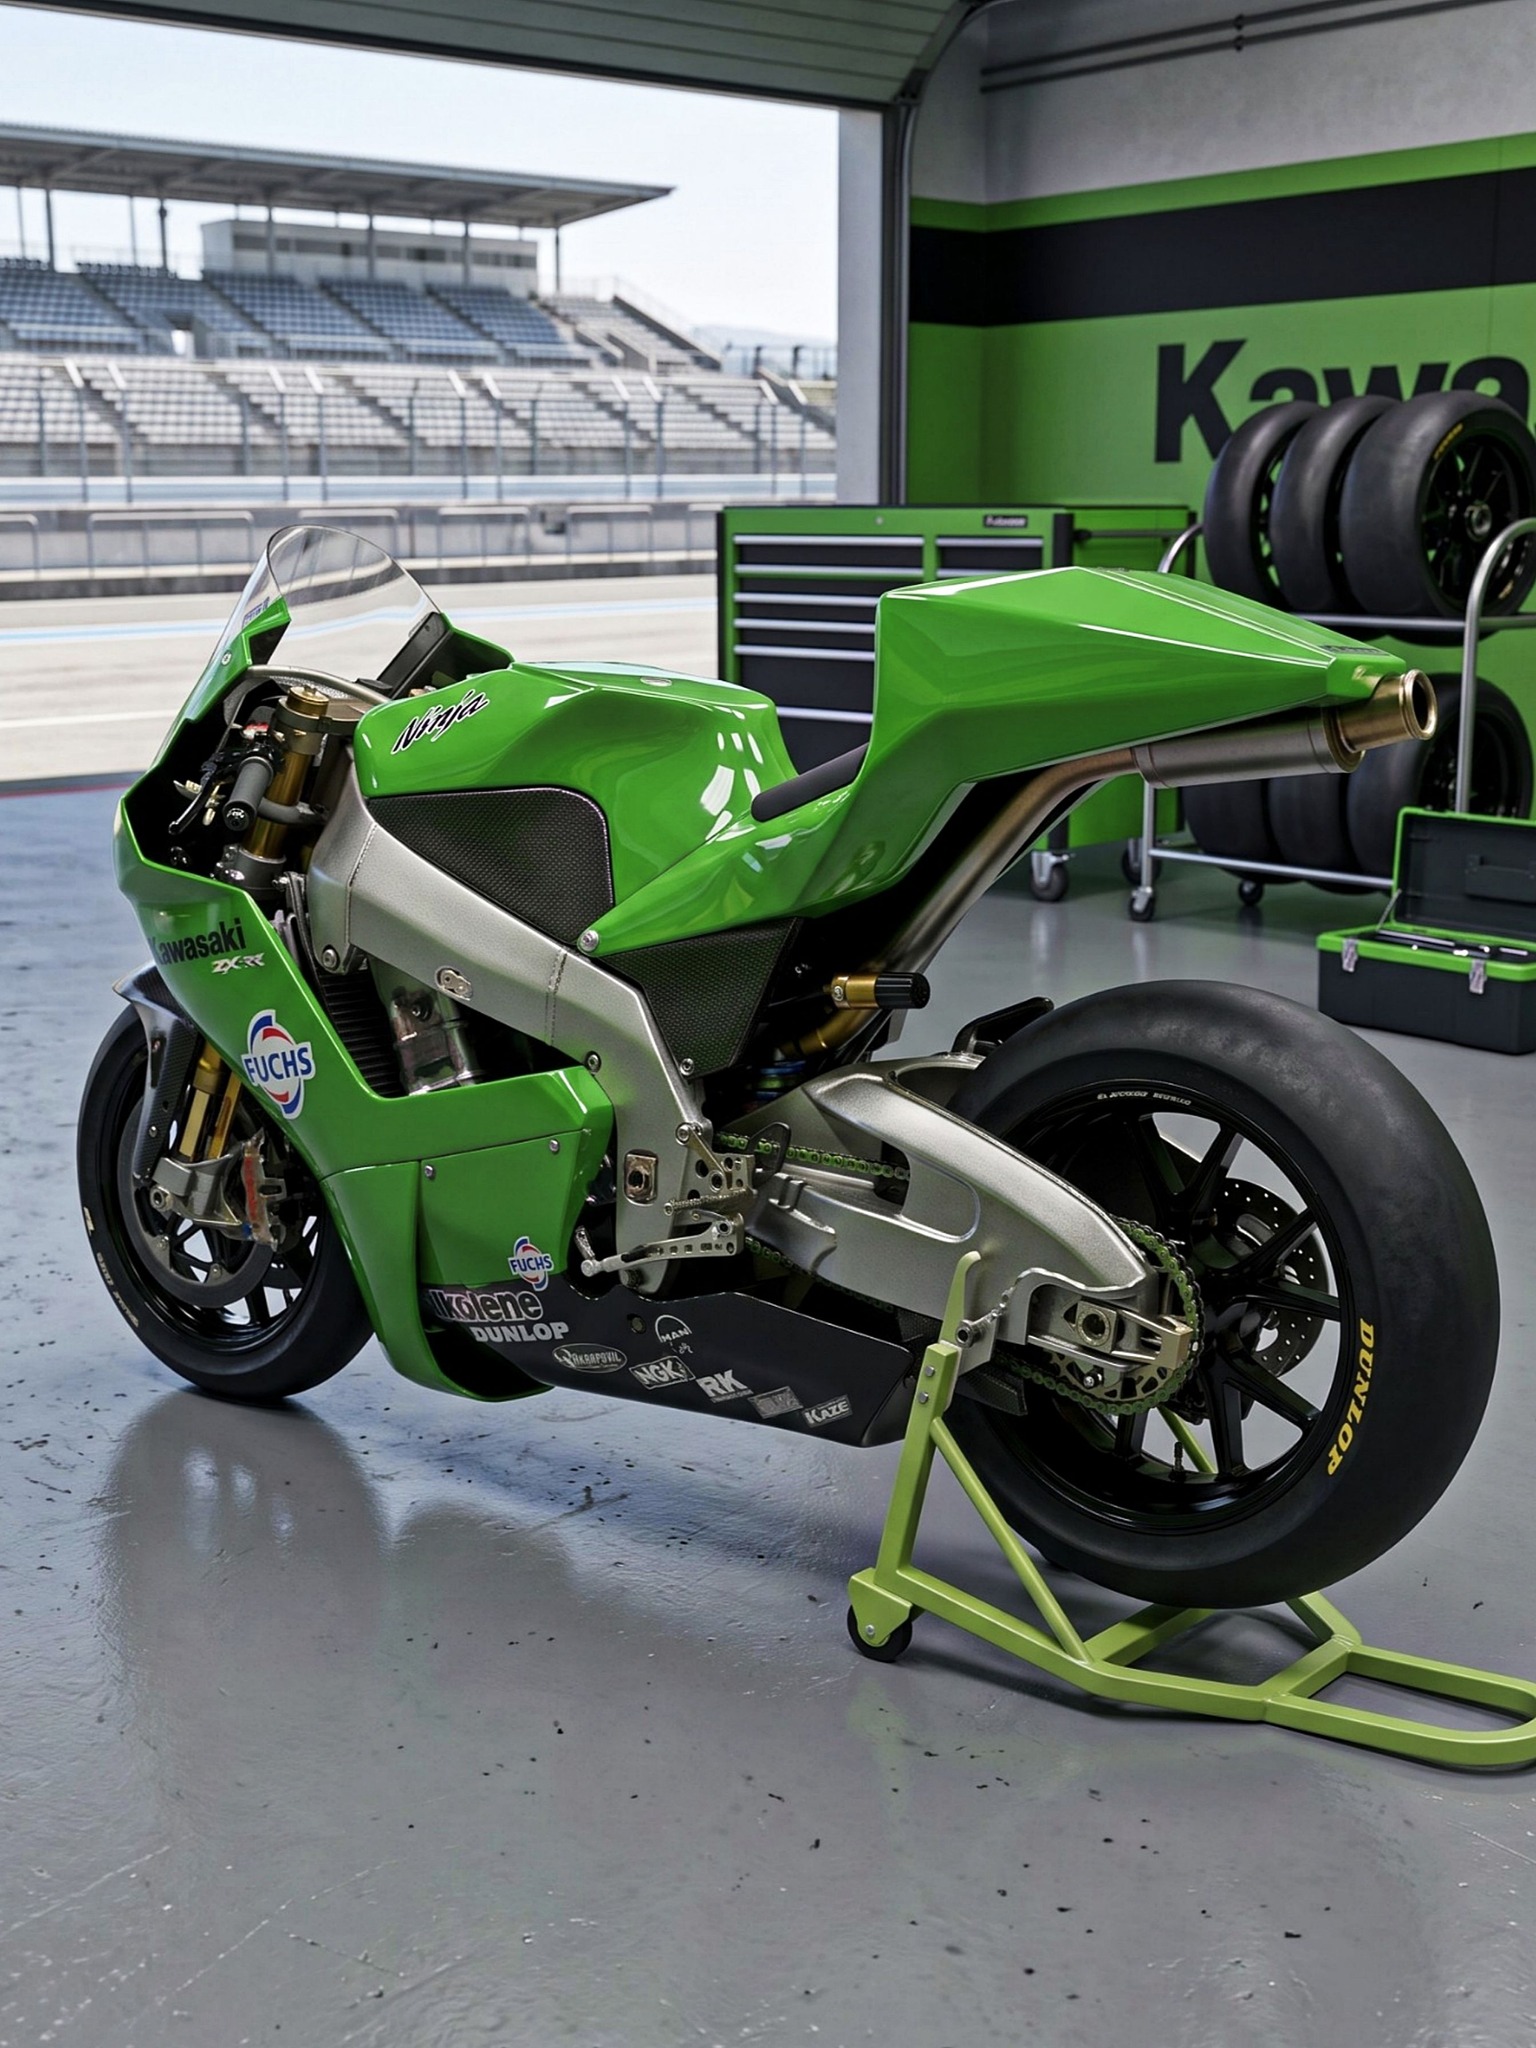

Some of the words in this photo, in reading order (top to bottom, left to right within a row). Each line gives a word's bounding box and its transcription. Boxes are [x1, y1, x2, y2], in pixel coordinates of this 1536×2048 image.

[391, 689, 490, 755] Ninja
[148, 918, 246, 966] Kawasaki
[244, 1047, 312, 1083] FUCHS
[510, 1255, 552, 1273] FUCHS
[469, 1322, 569, 1342] DUNLOP
[661, 1327, 691, 1343] MAN
[634, 1359, 685, 1385] NGK
[696, 1369, 748, 1397] RK
[1327, 1318, 1374, 1475] DUNLOP
[804, 1400, 849, 1424] KAZE
